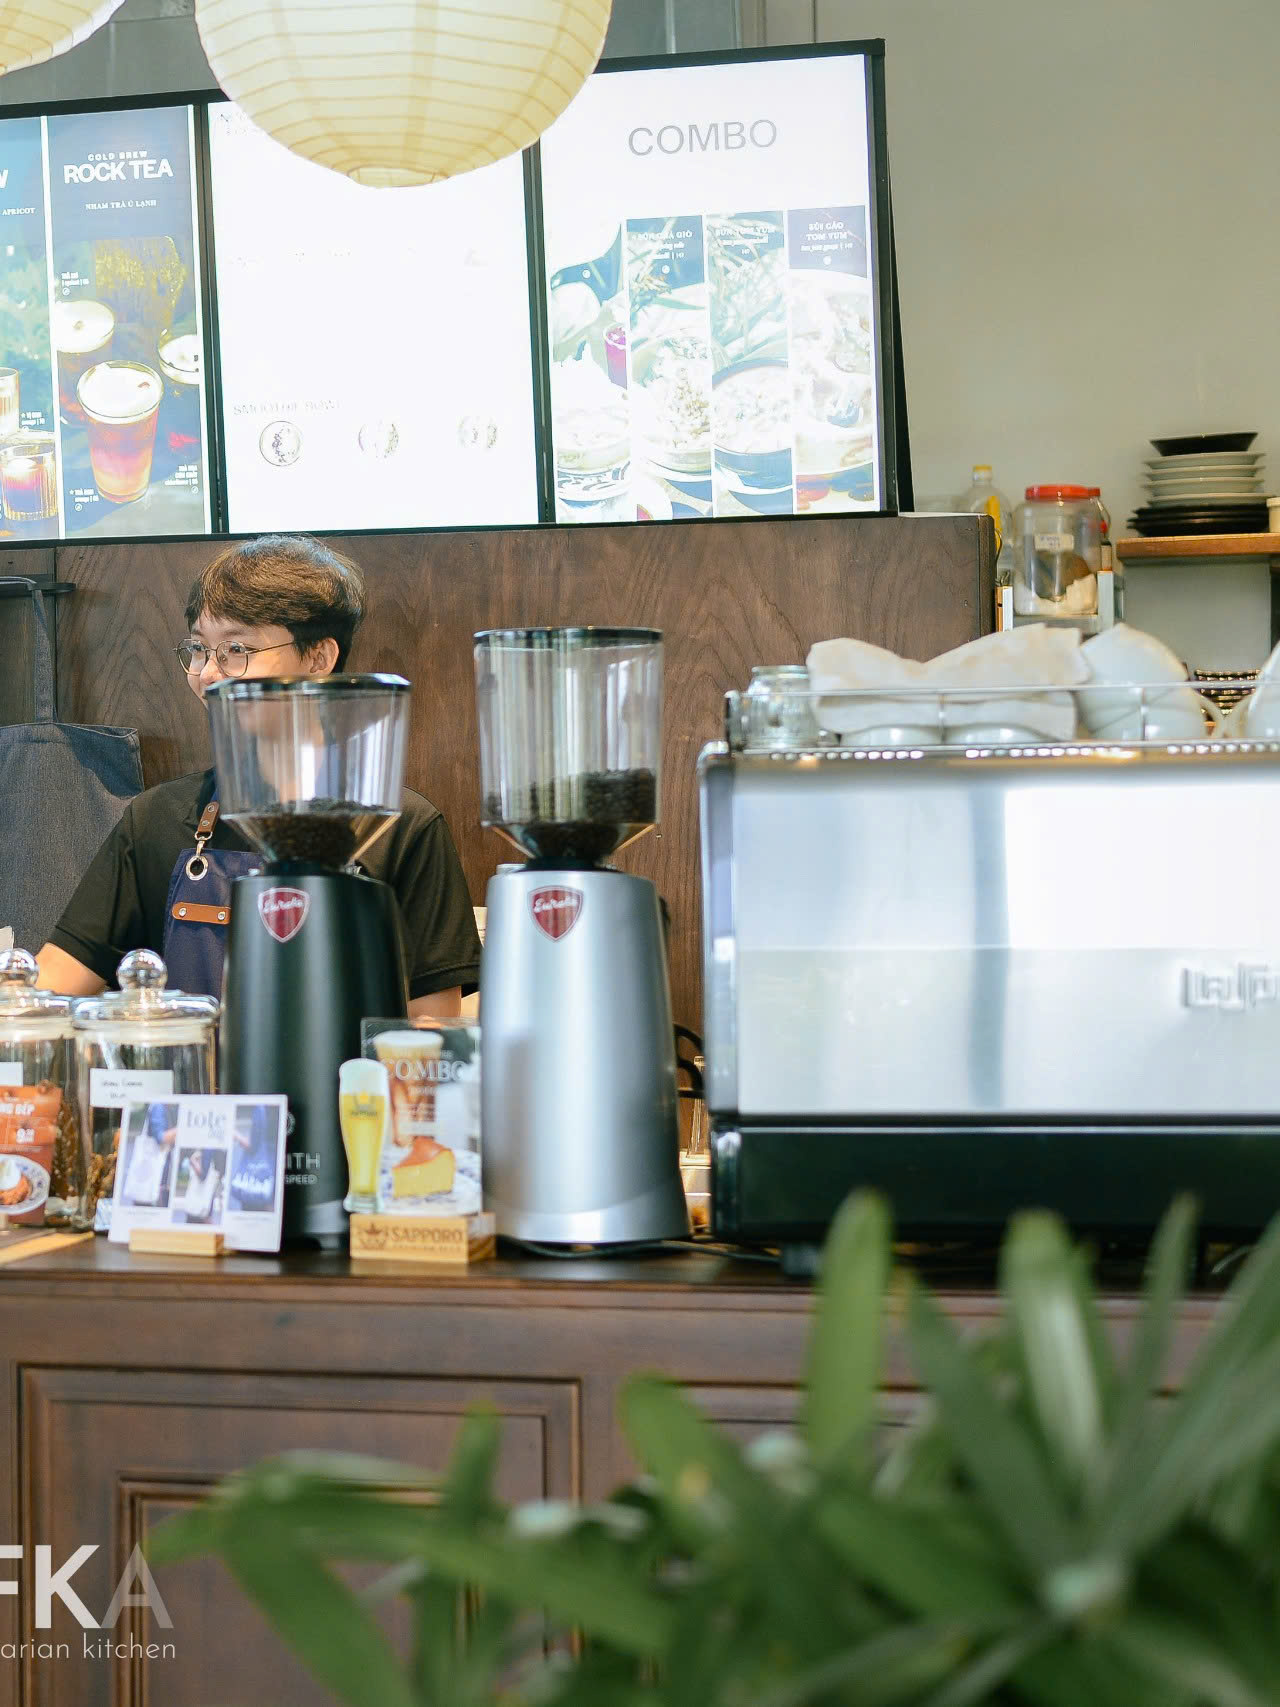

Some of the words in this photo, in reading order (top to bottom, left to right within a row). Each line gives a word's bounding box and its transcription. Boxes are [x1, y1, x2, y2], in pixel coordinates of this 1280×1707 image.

[628, 119, 777, 156] COMBO
[87, 152, 115, 161] COLD
[119, 150, 148, 160] BREW
[63, 161, 126, 184] ROCK
[128, 158, 174, 179] TEA
[2, 207, 36, 216] APRICOT
[391, 1226, 464, 1243] SAPPORO
